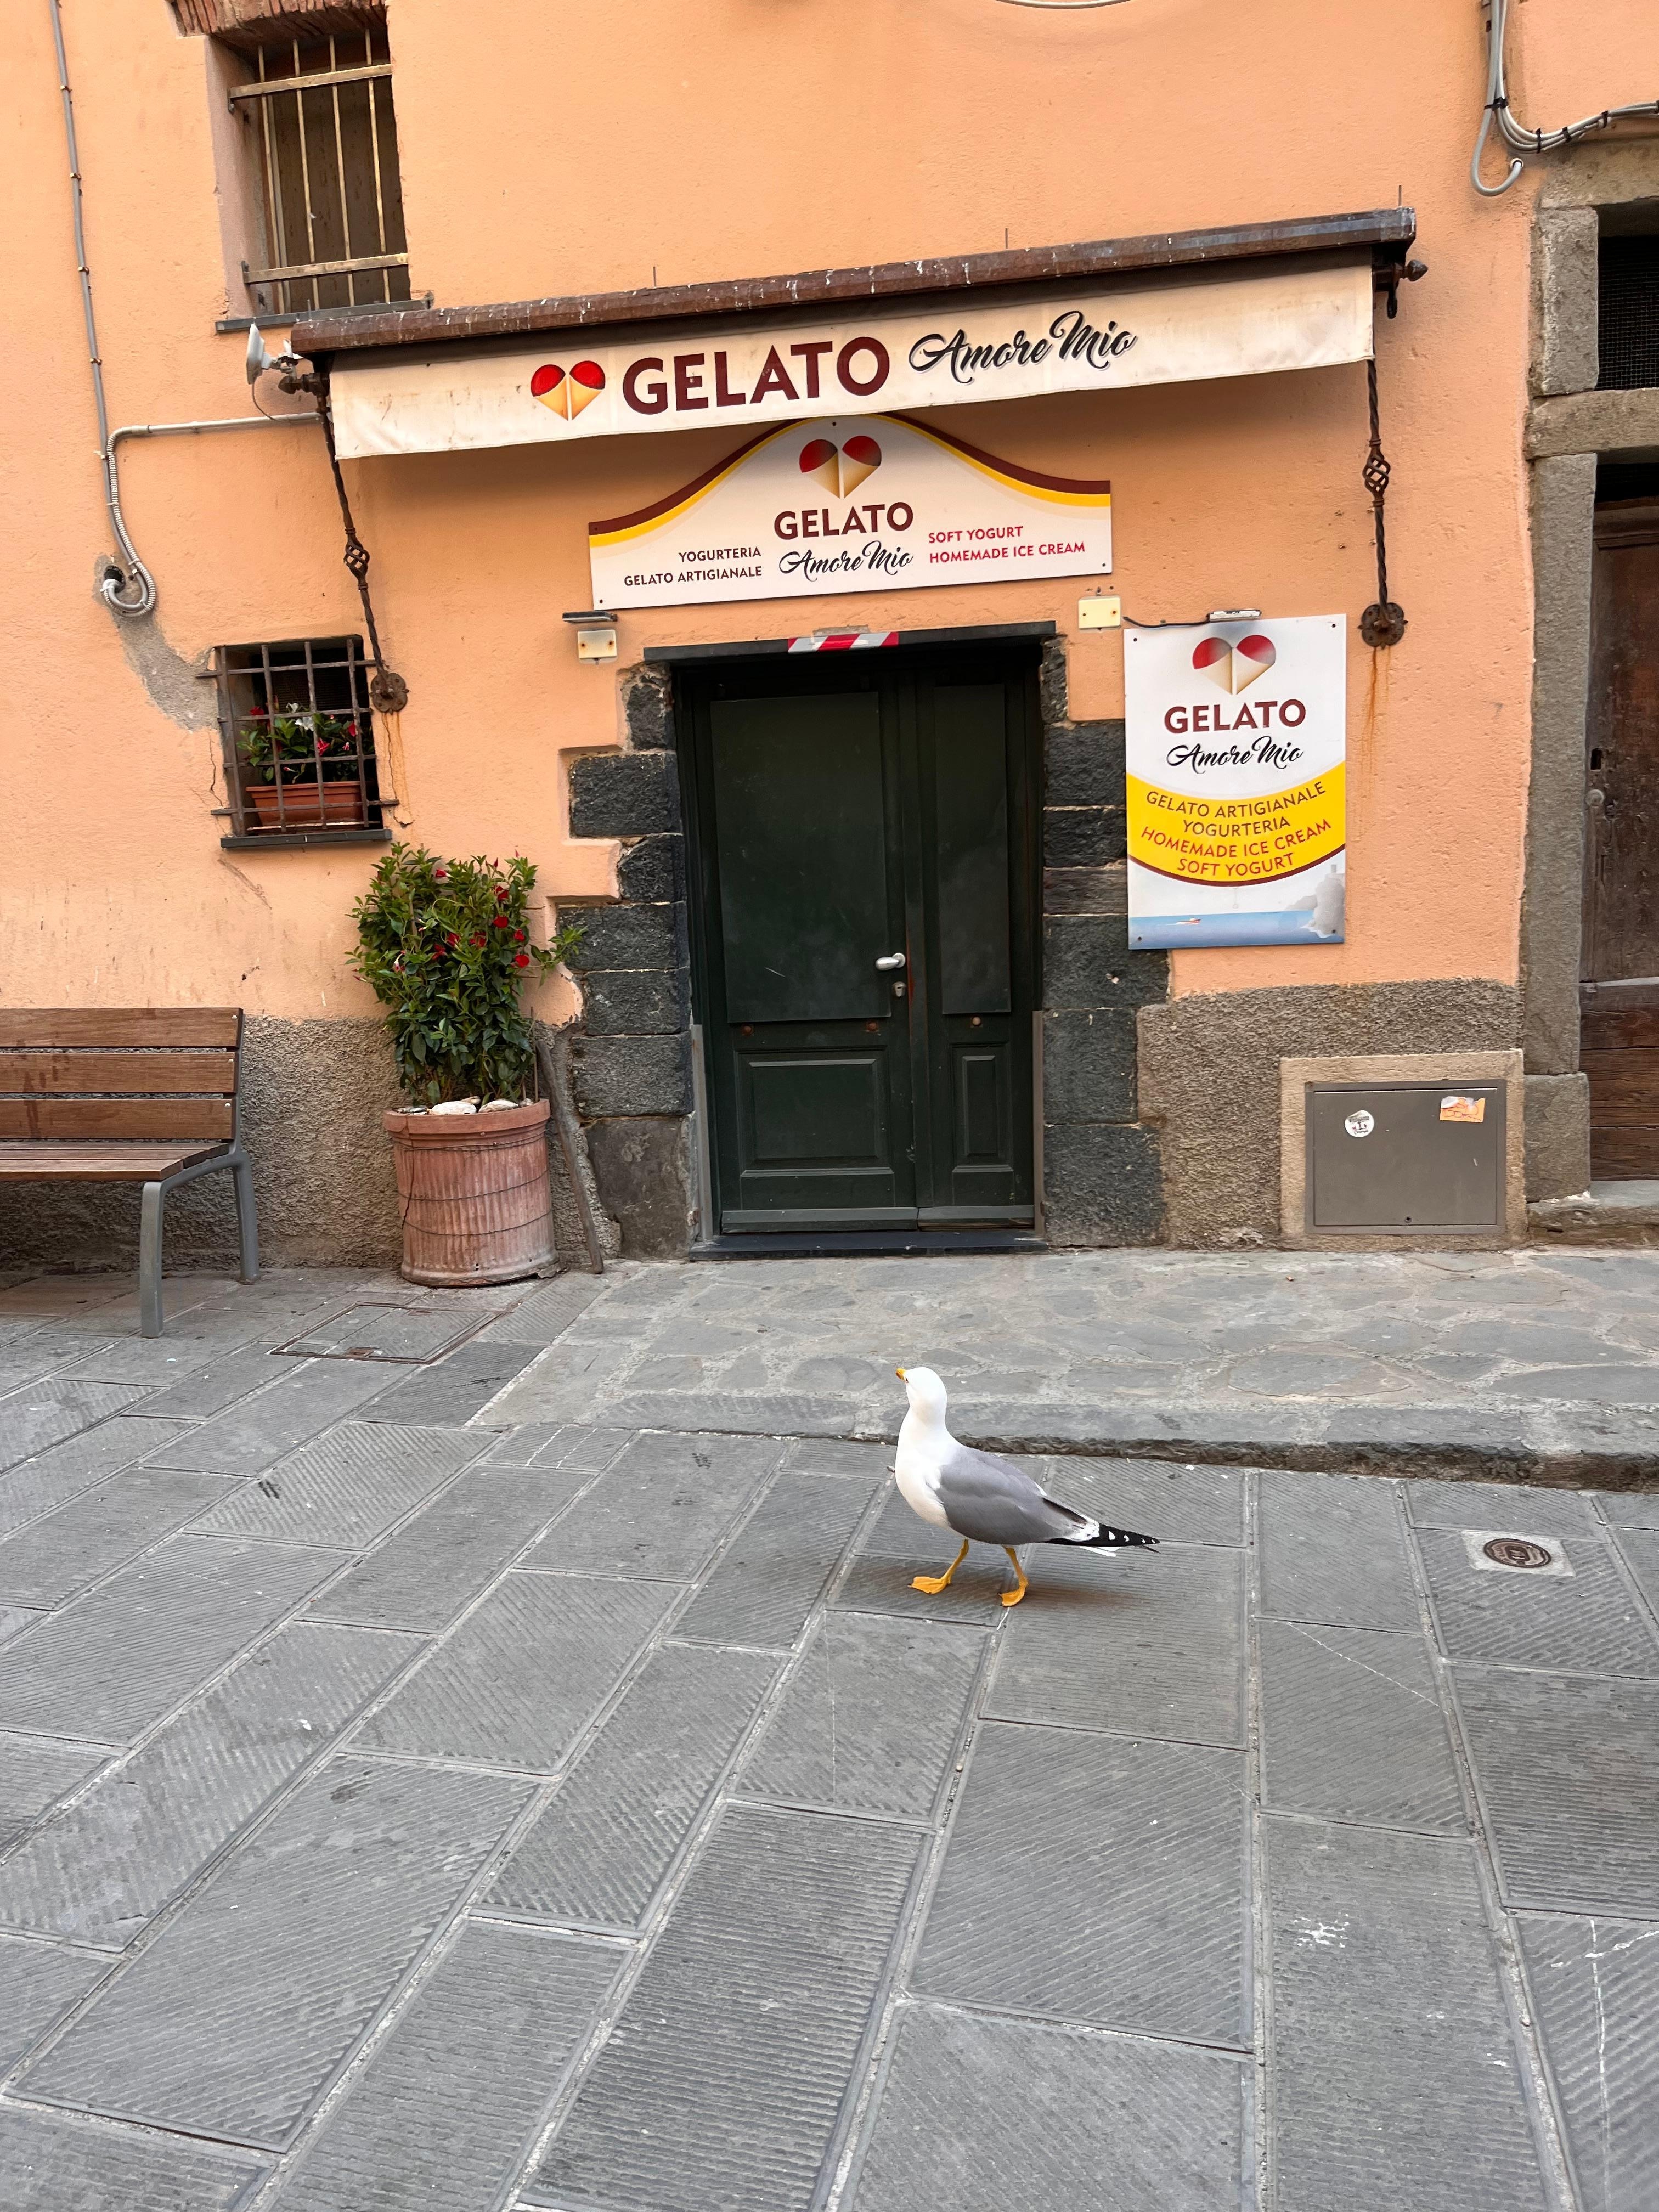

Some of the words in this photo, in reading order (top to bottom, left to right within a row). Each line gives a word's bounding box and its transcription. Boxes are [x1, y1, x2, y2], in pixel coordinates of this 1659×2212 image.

[622, 335, 890, 415] GELATO
[908, 329, 1053, 385] Amore
[1049, 310, 1137, 370] Mio
[774, 501, 913, 540] GELATO
[928, 531, 963, 544] SOFT
[966, 526, 1023, 541] YOGURT
[678, 546, 762, 562] YOGURTERIA
[778, 549, 864, 582] Amore
[861, 540, 913, 575] Mio
[929, 548, 1008, 563] HOMEMADE
[1013, 545, 1035, 557] ICE
[1039, 541, 1085, 555] CREAM
[624, 572, 674, 586] GELATO
[678, 565, 763, 582] ARTIGIANALE
[1164, 698, 1306, 734] GELATO
[1166, 743, 1253, 774] Amore
[1251, 735, 1304, 769] Mio
[1146, 791, 1210, 817] GELATO
[1214, 781, 1326, 819] ARTIGIANALE
[1141, 826, 1238, 858] HOMEMADE
[1243, 840, 1269, 857] ICE
[1274, 819, 1331, 850] CREAM
[1183, 815, 1291, 837] YOGURTERIA
[1177, 857, 1221, 876] SOFT
[1225, 852, 1294, 877] YOGURT
